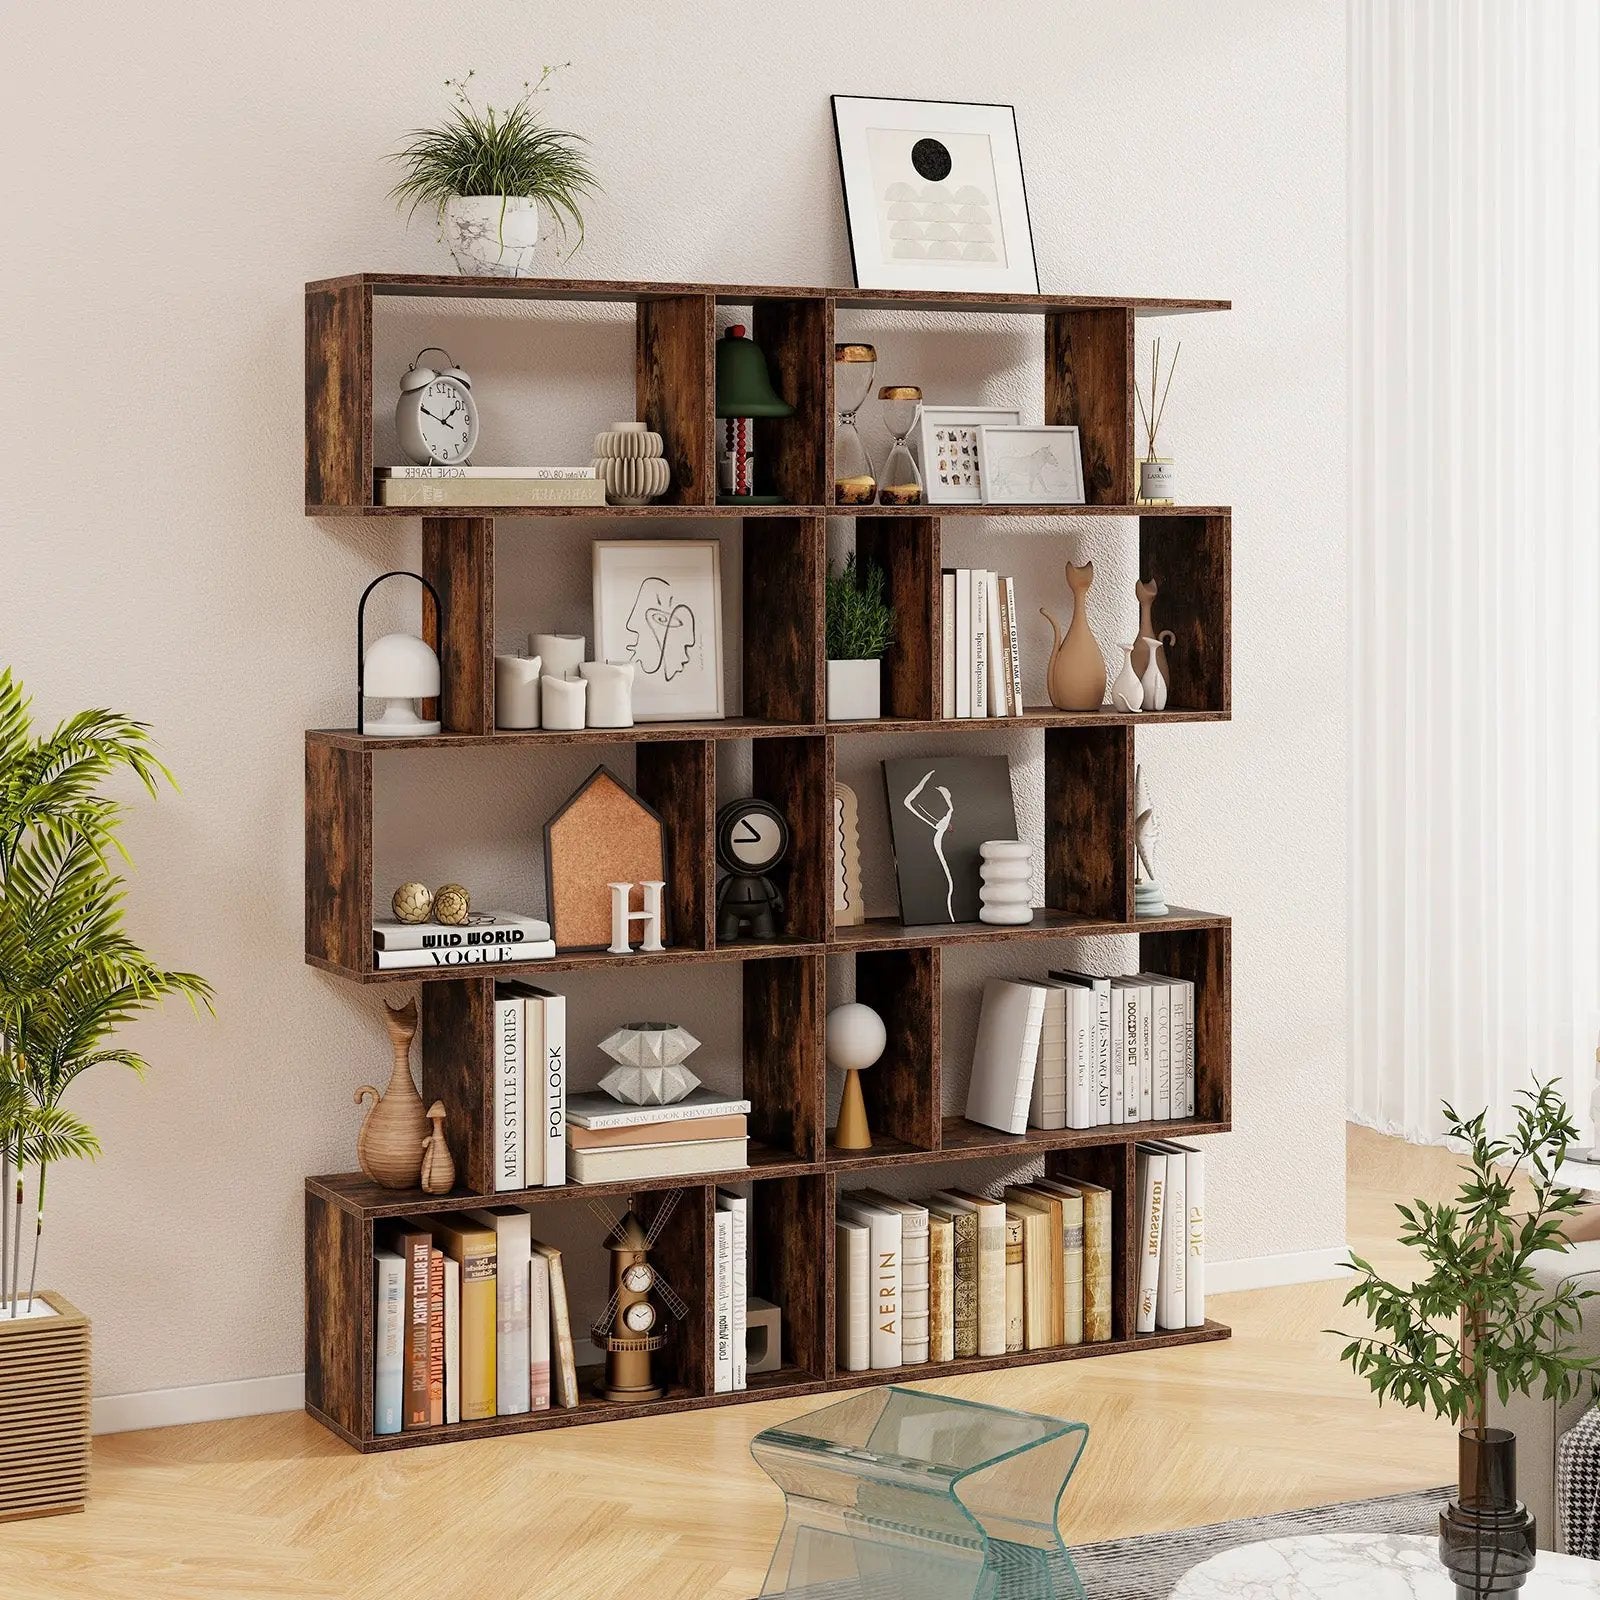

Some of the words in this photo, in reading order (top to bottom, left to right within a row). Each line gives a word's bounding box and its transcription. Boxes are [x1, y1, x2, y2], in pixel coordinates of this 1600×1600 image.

[975, 632, 984, 659] Братья
[1010, 625, 1019, 662] ГОВОРИ
[975, 661, 984, 708] Карамазовы
[422, 932, 462, 948] WILD
[467, 929, 525, 945] WORLD
[431, 946, 513, 966] VOGUE
[504, 1008, 516, 1075] STORIES
[1128, 1047, 1137, 1067] DIET
[1174, 1020, 1184, 1053] TWO
[549, 1046, 562, 1138] POLLOCK
[1159, 1049, 1169, 1104] CHANEL
[504, 1078, 516, 1127] STYLE
[625, 1115, 649, 1124] NEW
[651, 1111, 680, 1121] LOOK
[682, 1103, 748, 1118] REVOLUTION
[504, 1130, 516, 1178] MEN'S
[879, 1252, 896, 1335] AERIN
